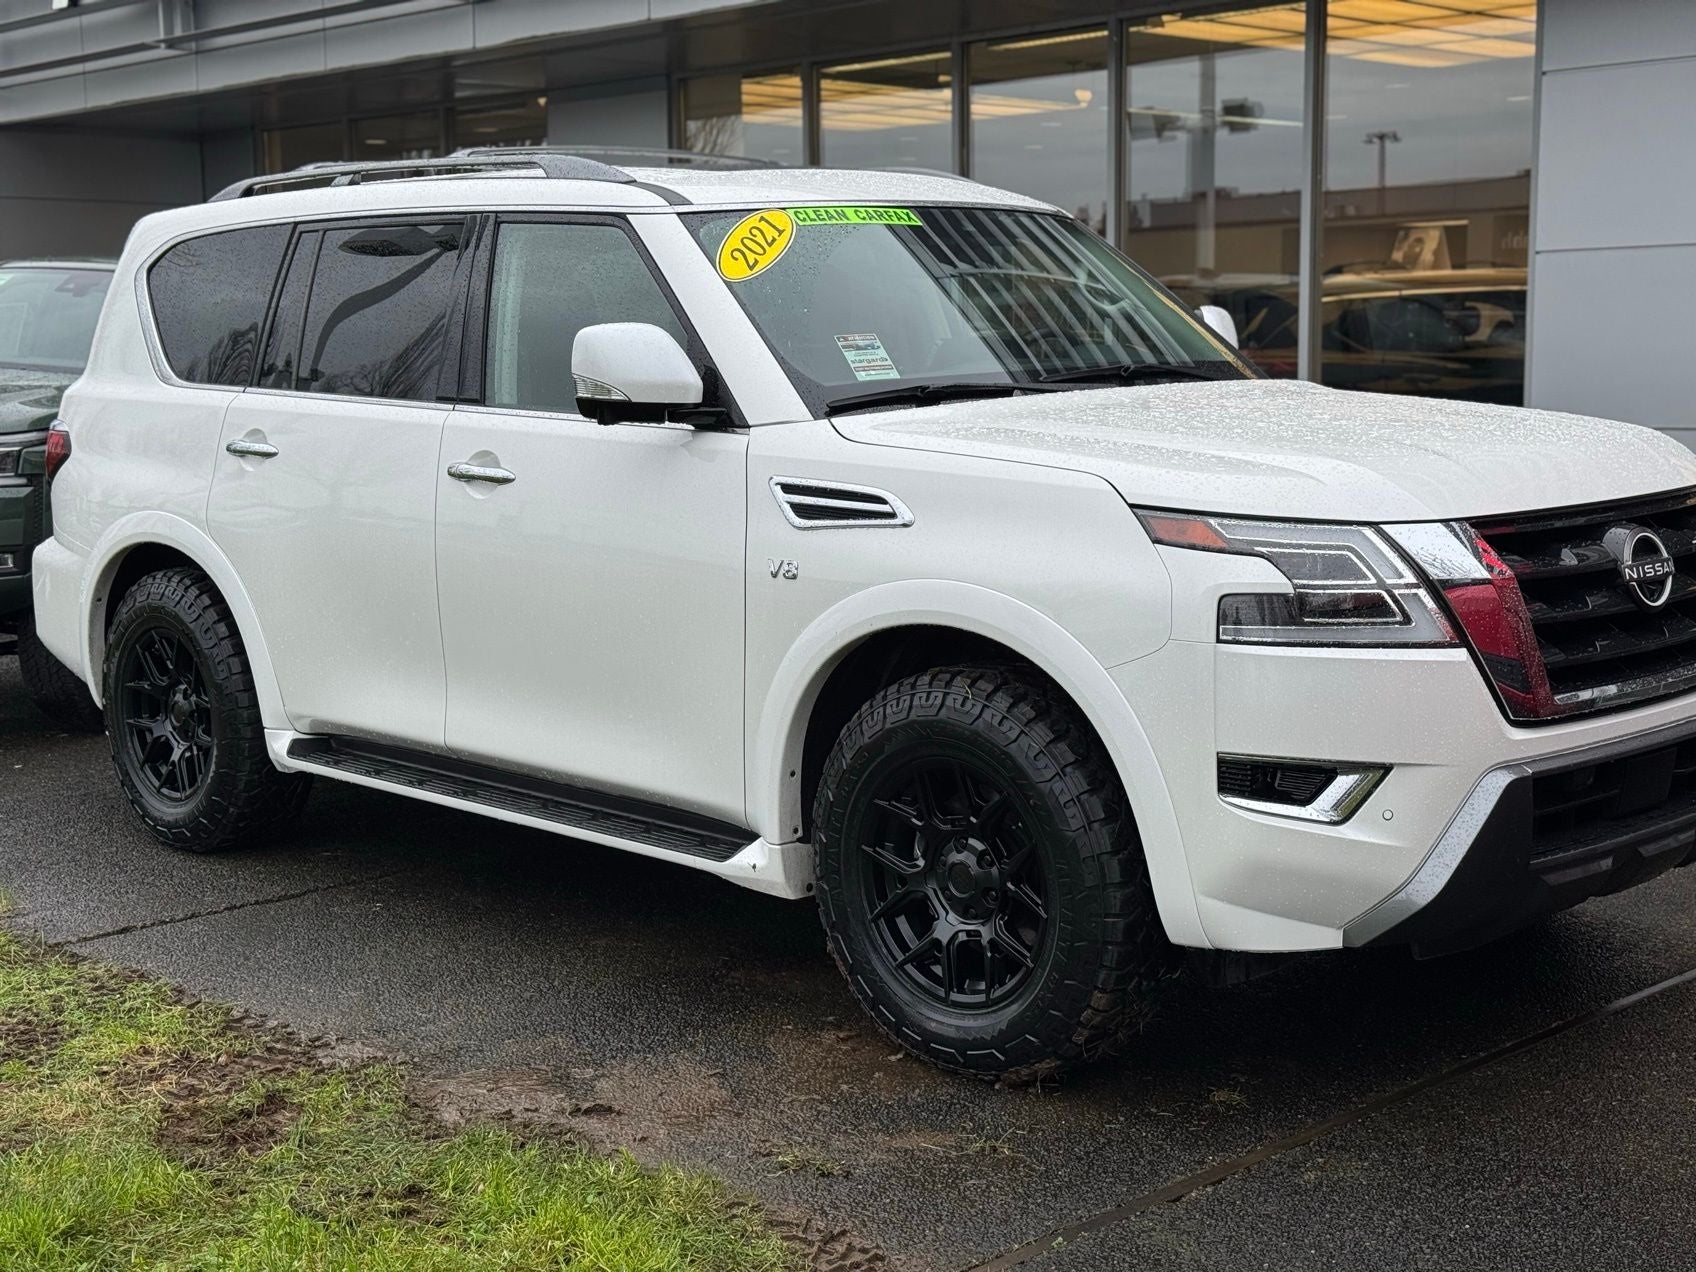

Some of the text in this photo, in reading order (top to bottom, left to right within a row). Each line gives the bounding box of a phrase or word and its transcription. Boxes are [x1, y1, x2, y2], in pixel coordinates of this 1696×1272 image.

[793, 208, 919, 224] CLEAN CARFAX
[730, 215, 786, 271] 2021
[767, 558, 799, 580] V8
[1625, 561, 1675, 580] NISSAN
